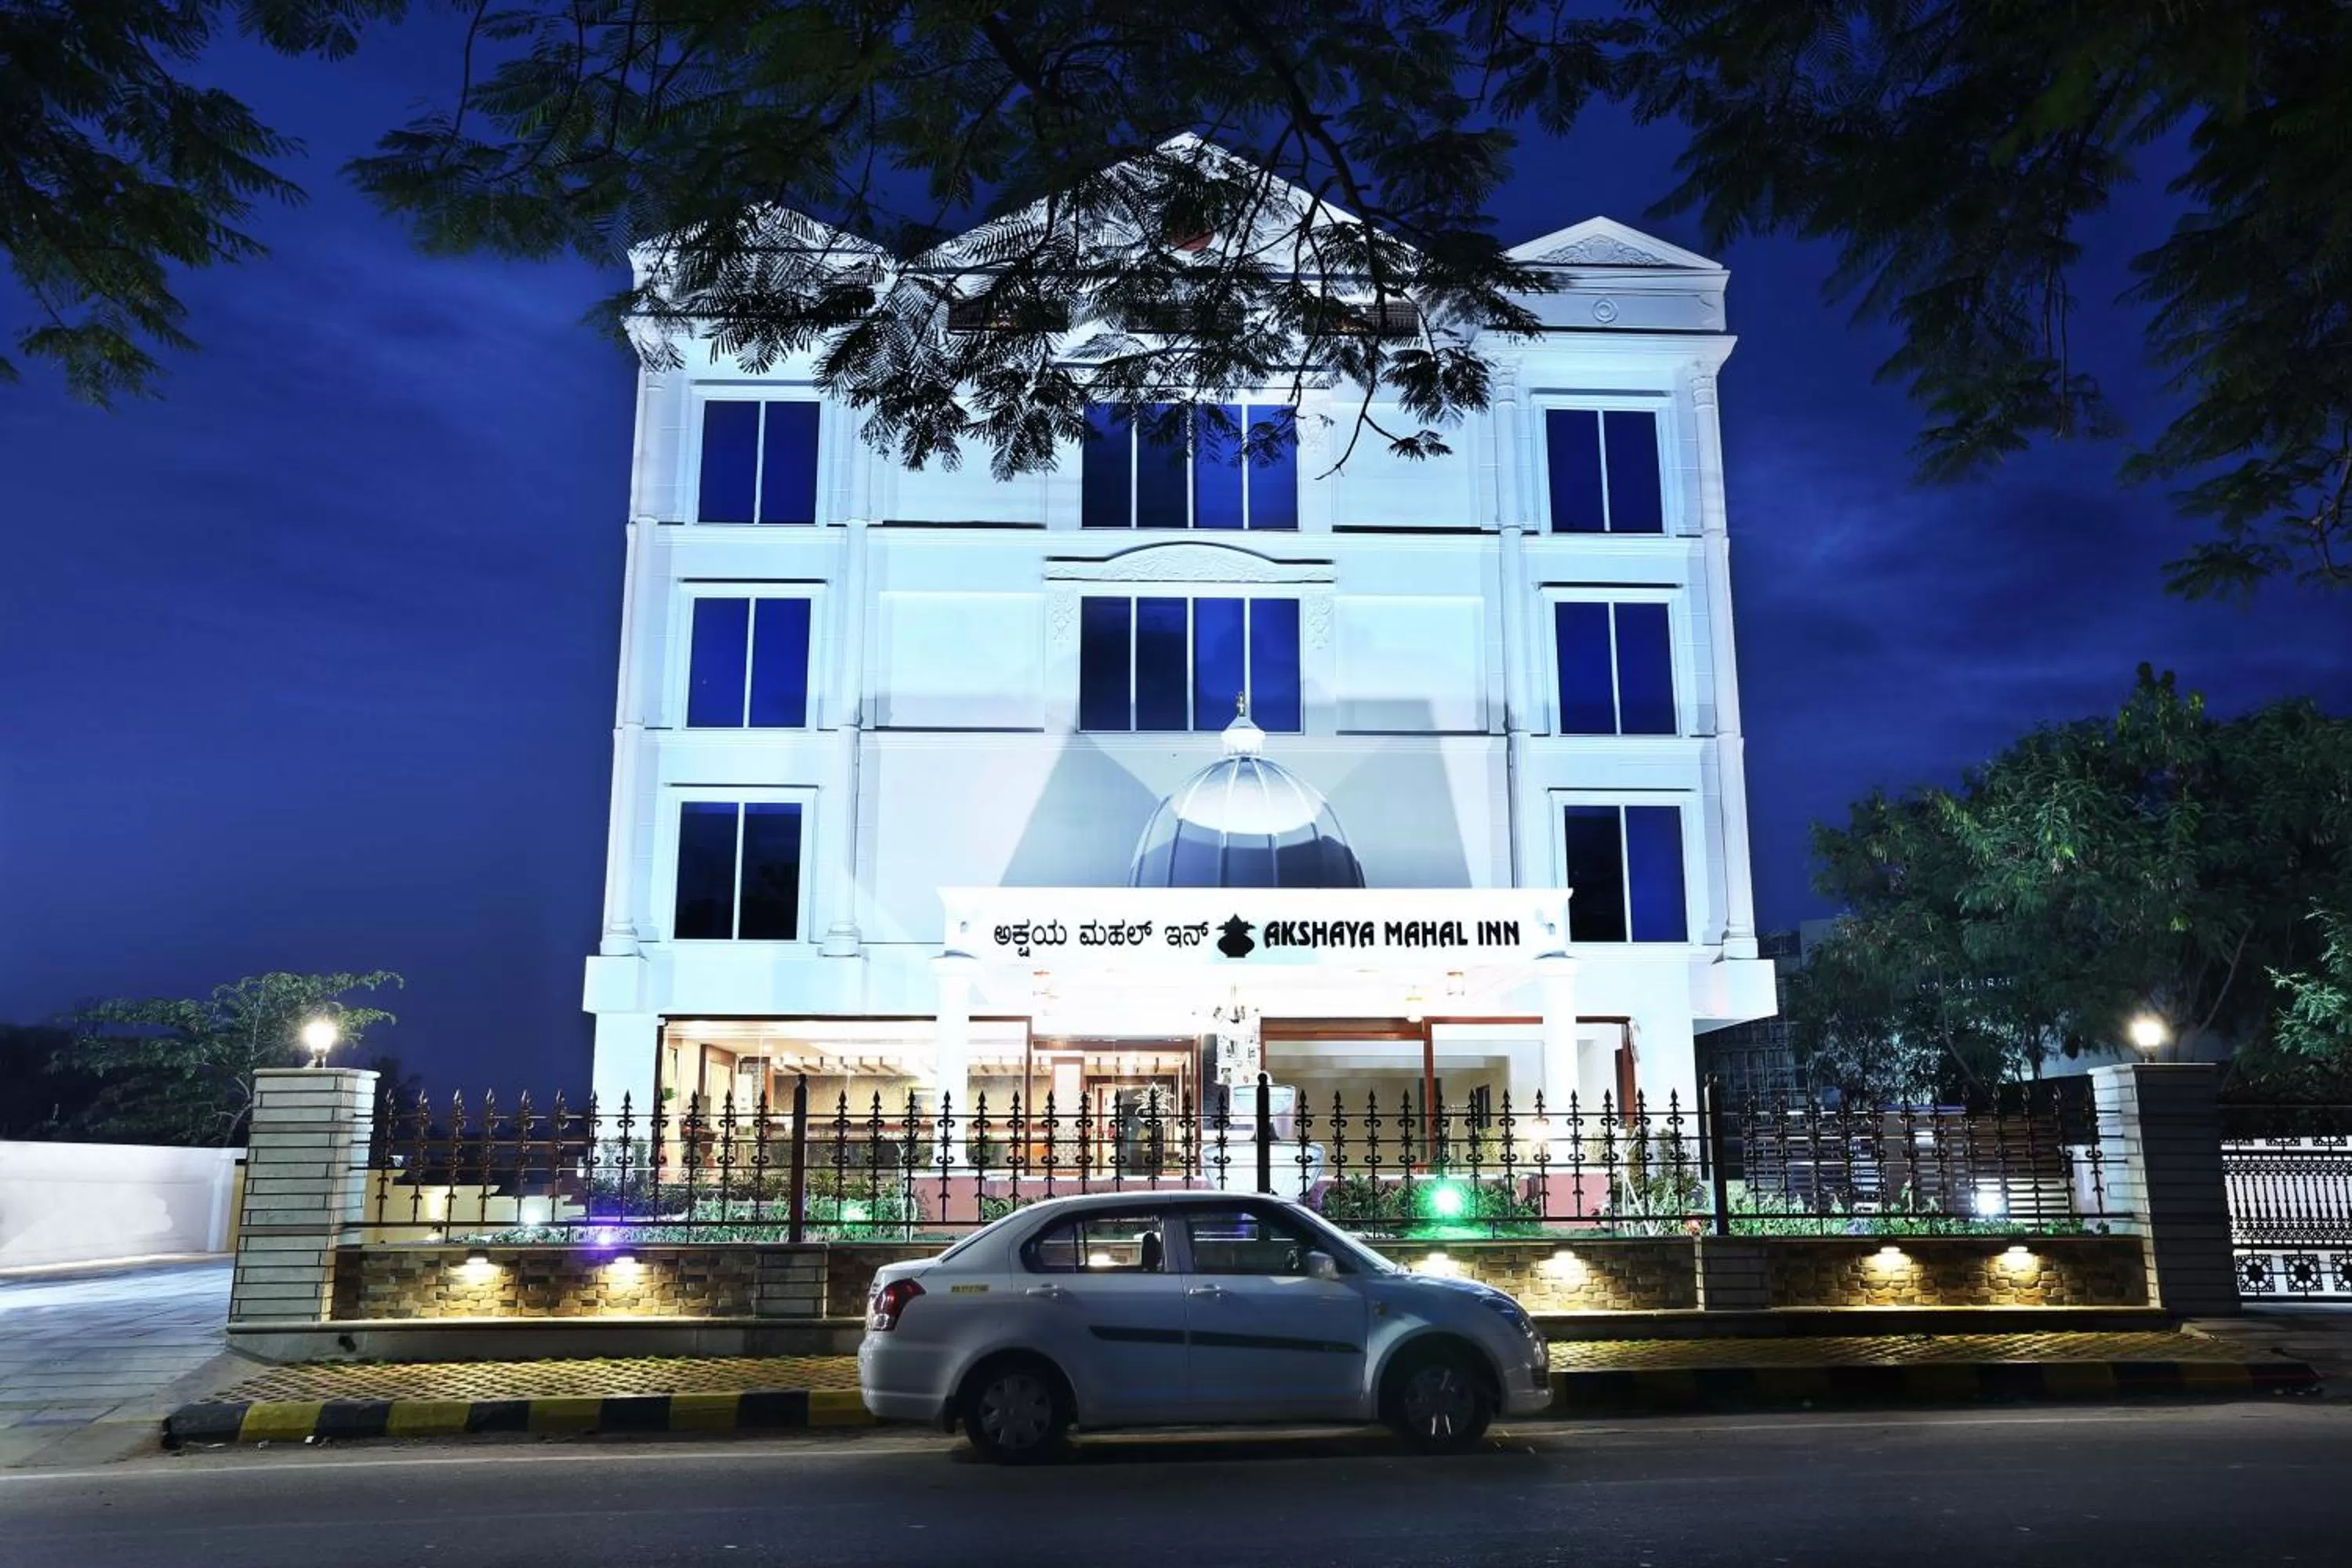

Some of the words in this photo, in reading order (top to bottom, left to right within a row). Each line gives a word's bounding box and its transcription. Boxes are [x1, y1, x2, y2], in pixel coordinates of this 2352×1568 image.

[993, 919, 1067, 957] ಅಕ್ಷಯ
[1080, 920, 1152, 946] ಮಹಲ್
[1164, 921, 1209, 948] ಇನ್
[1263, 920, 1374, 949] AKSHAYA
[1384, 921, 1468, 949] MAHAL
[1477, 920, 1520, 946] INN
